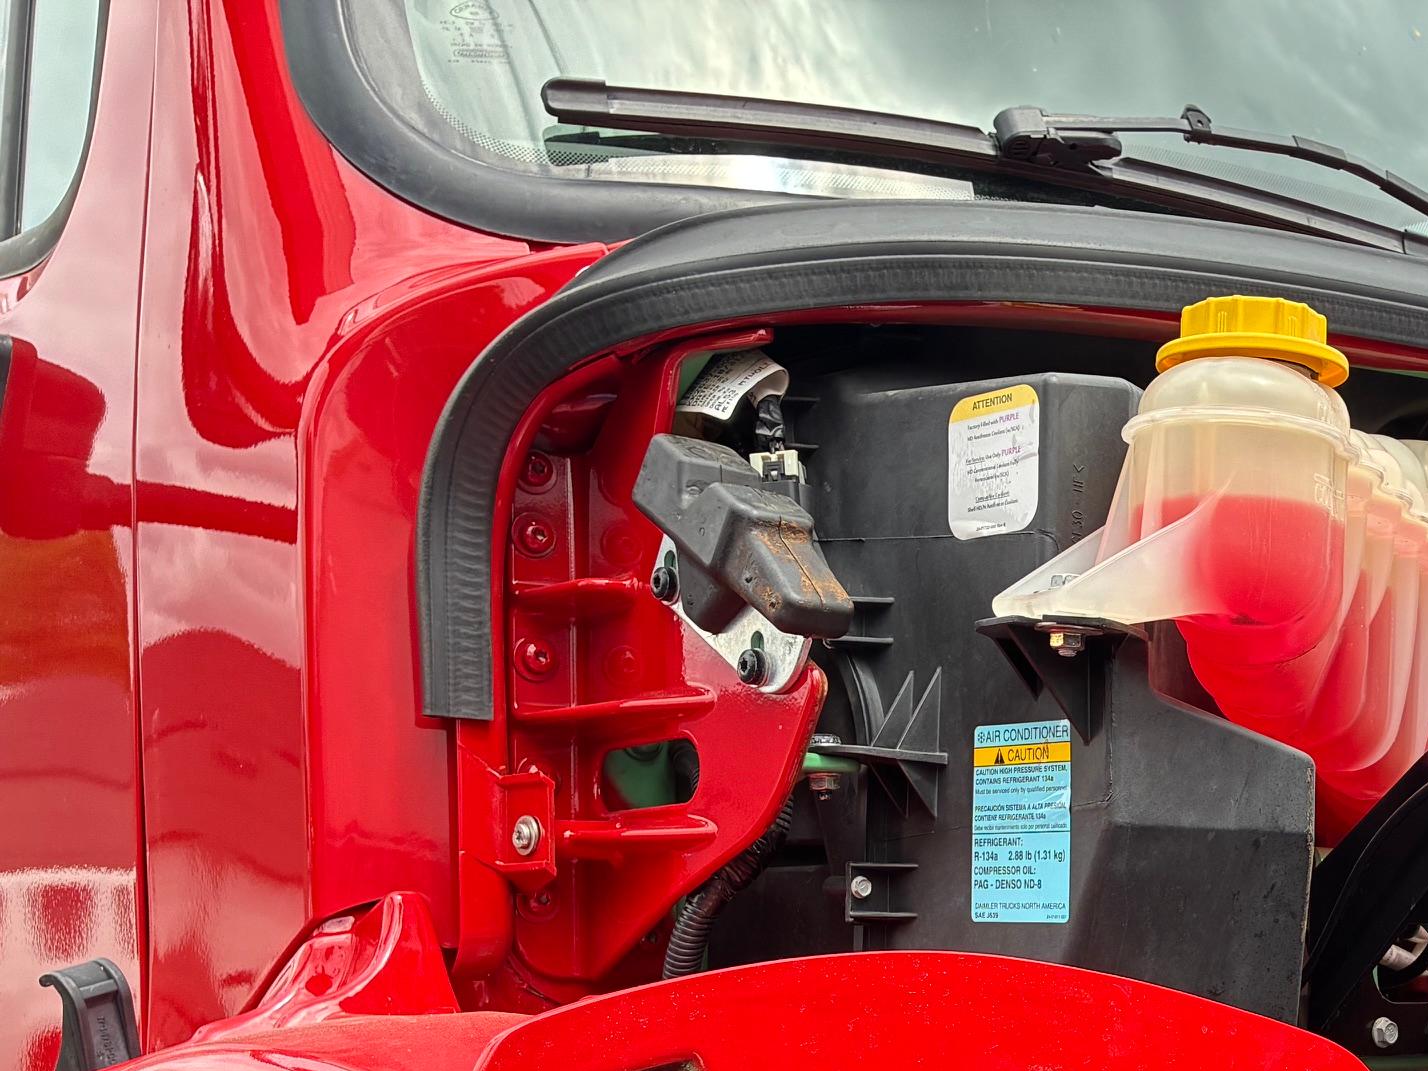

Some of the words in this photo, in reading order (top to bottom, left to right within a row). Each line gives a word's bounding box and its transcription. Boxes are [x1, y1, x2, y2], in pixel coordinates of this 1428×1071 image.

[972, 393, 1012, 410] ATTENTION
[999, 412, 1019, 423] PURPLE
[1001, 446, 1022, 457] PURPLE
[986, 730, 1000, 743] AIR
[1003, 725, 1069, 742] CONDITIONER
[1007, 745, 1049, 761] CAUTION
[976, 768, 998, 776] CAUTION
[1003, 776, 1040, 784] REFRIGERANT
[974, 837, 1023, 847] REFRIGERANT:
[974, 851, 998, 861] R-134a
[1008, 851, 1023, 860] 2.88
[1025, 850, 1032, 860] lb
[1034, 850, 1051, 862] (1.31
[1054, 849, 1065, 862] kg)
[974, 866, 1020, 875] COMPRESSOR
[1023, 866, 1036, 875] OIL:
[974, 880, 988, 889] PAG
[995, 879, 1022, 889] DENSO
[1024, 879, 1041, 889] ND-8
